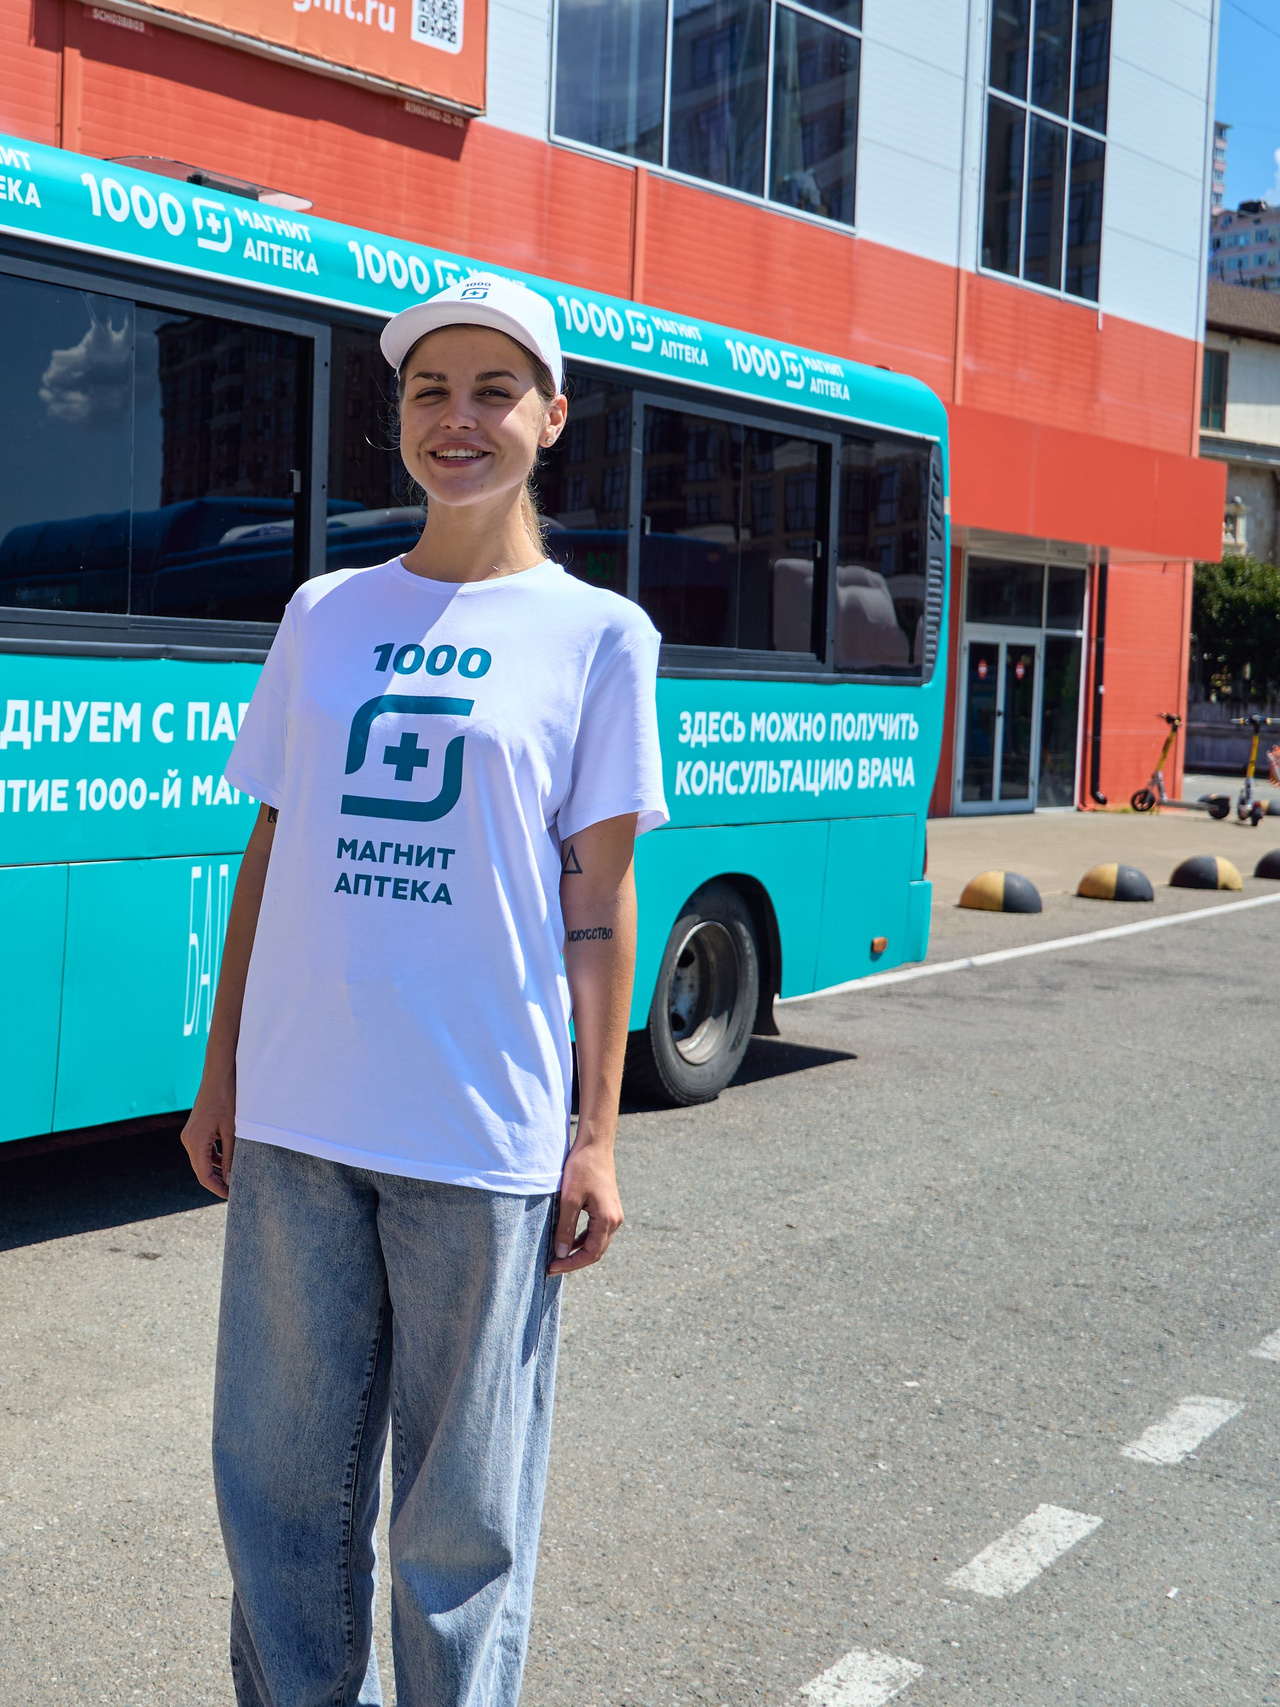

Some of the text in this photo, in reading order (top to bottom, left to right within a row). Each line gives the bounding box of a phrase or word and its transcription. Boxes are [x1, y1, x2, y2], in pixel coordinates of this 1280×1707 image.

[80, 172, 186, 237] 1000
[233, 206, 312, 243] МАГНИТ
[243, 237, 320, 276] АПТЕКА
[347, 240, 431, 295] 1000
[557, 295, 624, 341] 1000
[650, 315, 702, 341] МАГНИТ
[660, 339, 709, 367] АПТЕКА
[724, 339, 780, 380] 1000
[801, 354, 845, 378] МАГНИТ
[809, 376, 850, 401] АПТЕКА
[373, 642, 492, 679] 1000
[152, 702, 175, 743] С
[678, 711, 919, 748] ЗДЕСЬ МОЖНО ПОЛУЧИТЬ
[76, 768, 182, 811] 1000-Й
[675, 756, 915, 797] КОНСУЛЬТАЦИЮ ВРАЧА
[336, 837, 456, 870] МАГНИТ
[334, 872, 453, 905] АПТЕКА
[567, 927, 613, 942] ИСКУССТВО
